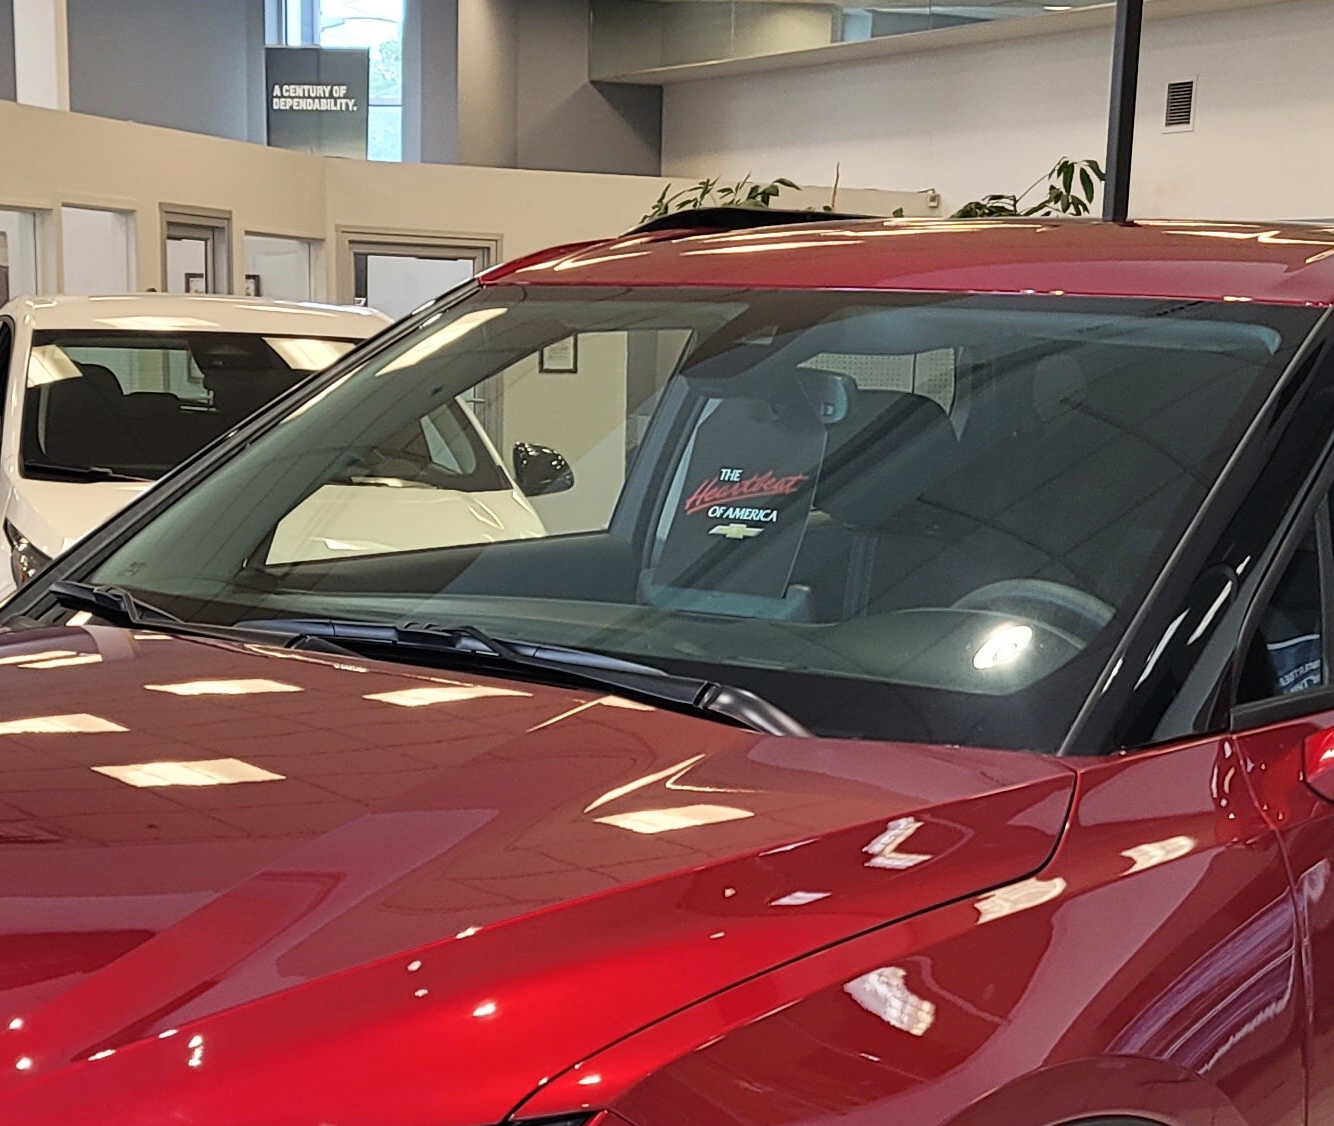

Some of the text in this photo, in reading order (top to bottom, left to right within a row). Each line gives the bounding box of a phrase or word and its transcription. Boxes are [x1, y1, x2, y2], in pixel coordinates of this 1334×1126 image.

[273, 85, 347, 98] A CENTURY OF
[272, 98, 357, 111] DEPENDABILITY.
[720, 468, 743, 482] THE
[685, 470, 809, 516] Heartbeat
[708, 506, 778, 522] OF AMERICA
